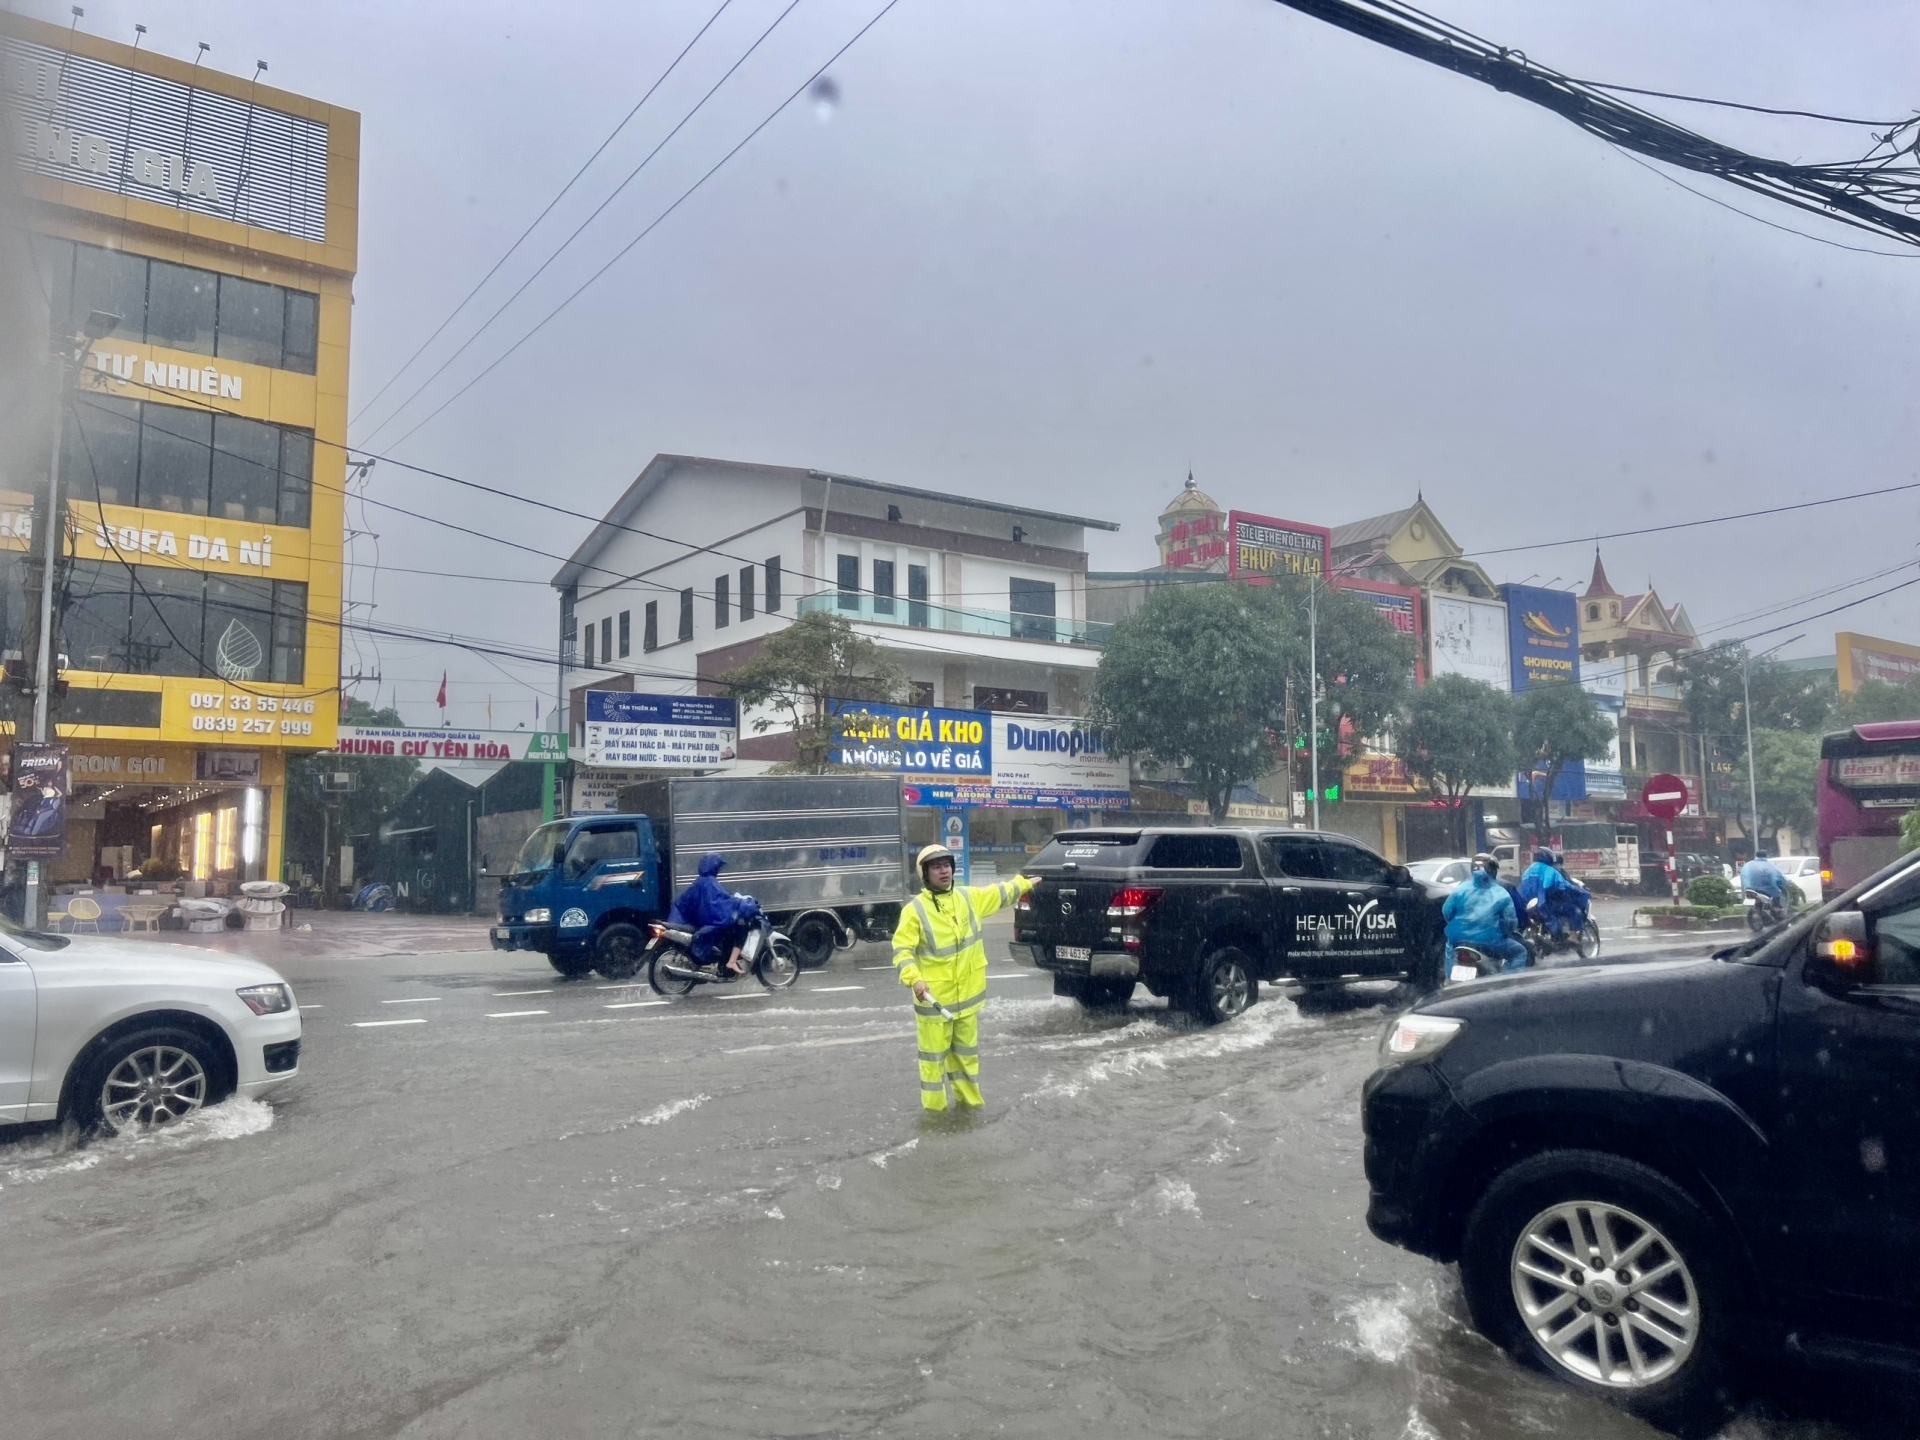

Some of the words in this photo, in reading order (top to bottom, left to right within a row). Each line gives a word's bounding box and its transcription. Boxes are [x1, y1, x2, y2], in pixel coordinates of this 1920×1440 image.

[132, 148, 220, 202] GIA
[94, 350, 138, 386] TỰ
[144, 359, 242, 400] NHIÊN
[95, 523, 178, 557] SOFA
[188, 533, 230, 562] DA
[1523, 656, 1573, 671] SHOWROOM
[190, 692, 225, 710] 097
[230, 694, 252, 711] 33
[257, 696, 279, 713] 55
[281, 698, 314, 715] 446
[192, 716, 237, 732] 0839
[242, 718, 276, 734] 257
[280, 719, 312, 735] 999
[608, 726, 623, 735] MÁY
[625, 726, 638, 735] XÂY
[640, 727, 658, 738] DỰNG
[664, 728, 679, 738] MÁY
[680, 728, 696, 738] CÔNG
[698, 729, 716, 738] TRÌNH
[897, 711, 934, 742] GIÁ
[939, 719, 983, 744] KHO
[381, 729, 401, 737] NHÂN
[402, 730, 416, 738] DÂN
[401, 740, 429, 756] CƯ
[432, 740, 468, 758] YÊN
[540, 734, 559, 750] 9A
[605, 739, 620, 748] MÁY
[622, 740, 637, 748] KHAI
[639, 740, 656, 749] THÁC
[672, 740, 687, 750] MÁY
[688, 741, 704, 750] PHÁT
[705, 741, 719, 751] ĐIỆN
[21, 758, 60, 767] FRIDAY
[605, 752, 620, 761] MÁY
[663, 753, 681, 763] DỤNG
[682, 754, 691, 763] CỤ
[708, 755, 718, 763] TAY
[842, 745, 902, 765] KHÔNG
[905, 751, 927, 767] LO
[930, 746, 952, 768] VỀ
[955, 750, 982, 769] GIÁ
[956, 791, 991, 799] AROMA
[994, 792, 1034, 800] CLASSIC
[1367, 914, 1396, 929] USA
[1296, 934, 1315, 942] Best
